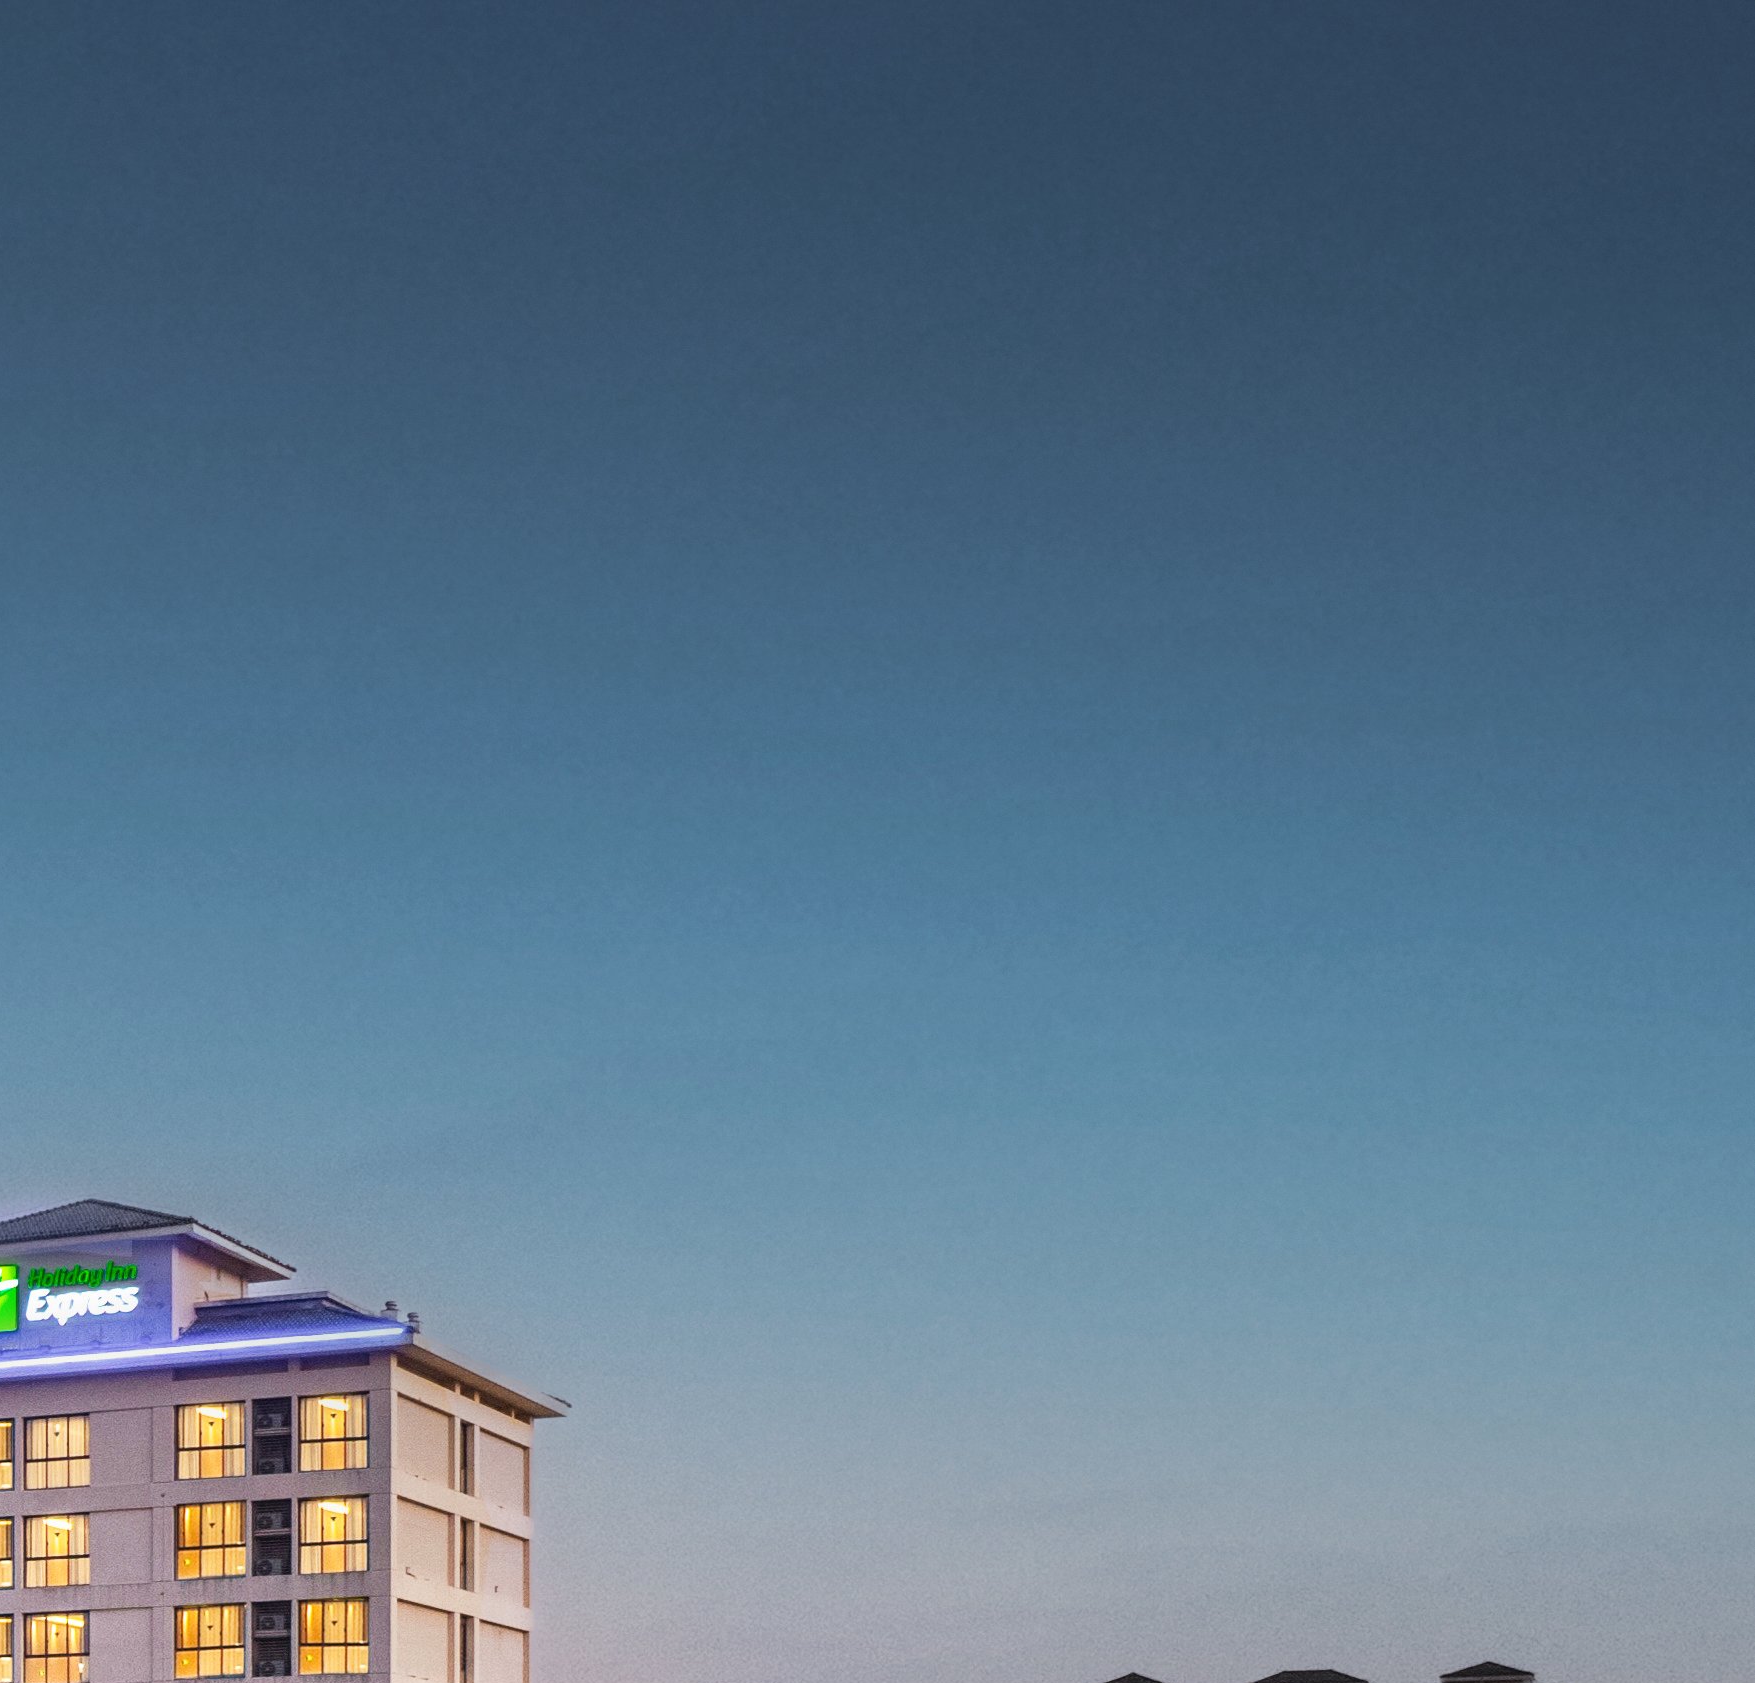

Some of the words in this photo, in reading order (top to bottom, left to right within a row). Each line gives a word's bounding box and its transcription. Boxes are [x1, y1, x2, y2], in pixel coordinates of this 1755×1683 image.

[28, 1264, 104, 1289] Holiday
[105, 1260, 138, 1281] Inn
[26, 1287, 139, 1326] Express
